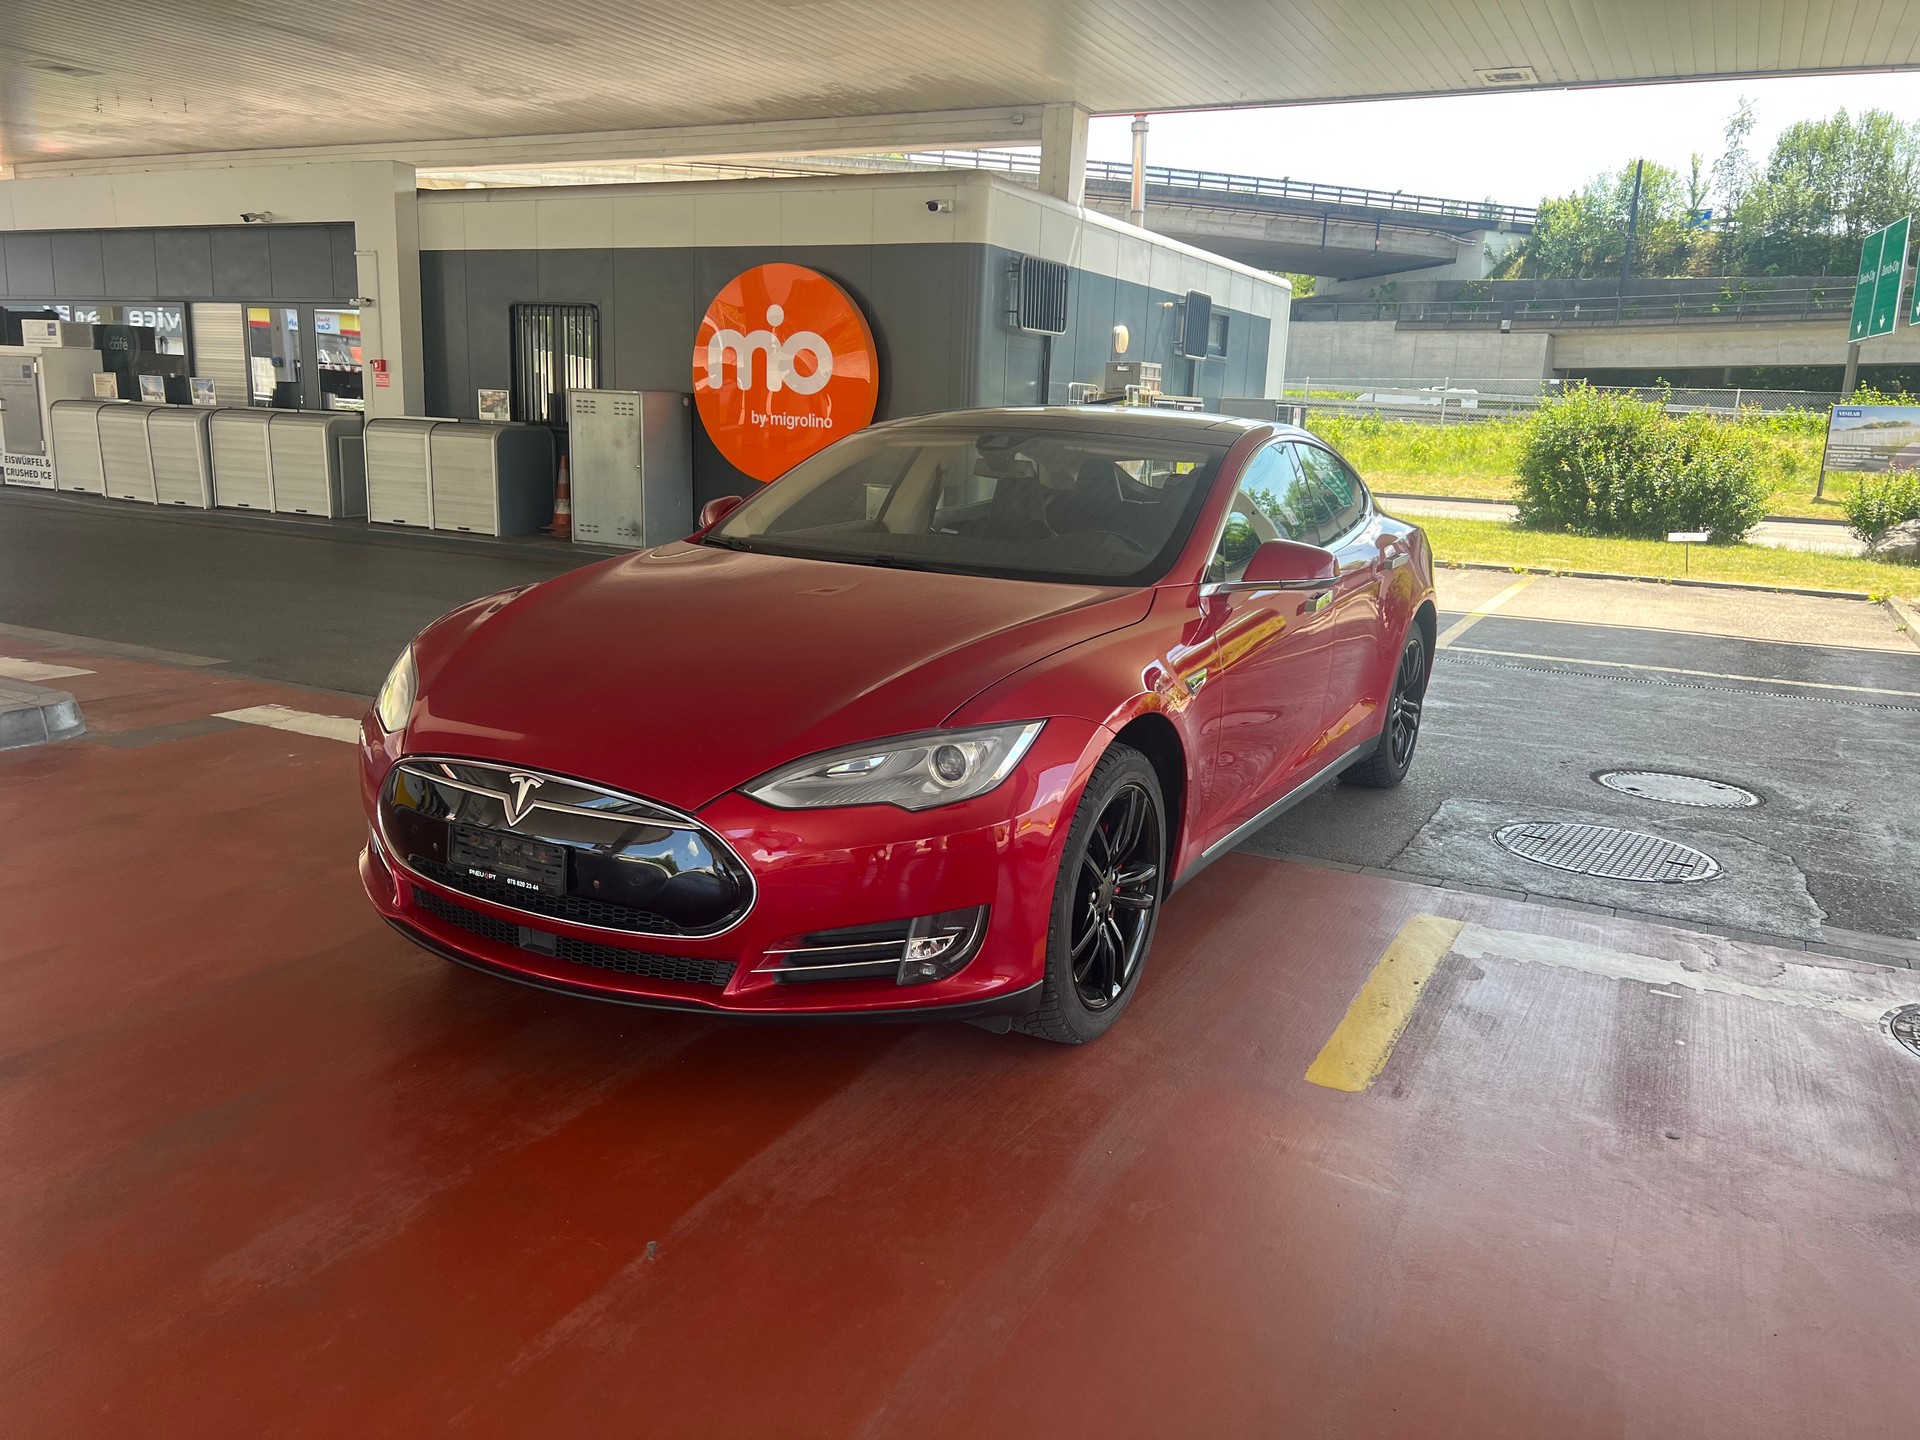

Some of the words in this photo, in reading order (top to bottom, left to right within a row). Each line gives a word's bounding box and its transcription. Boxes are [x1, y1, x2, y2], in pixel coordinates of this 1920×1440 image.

[109, 337, 129, 351] café
[708, 304, 833, 395] mio
[751, 410, 767, 428] by
[770, 412, 833, 429] migrolino
[4, 455, 44, 467] EISWÜRFEL
[45, 459, 51, 468] &
[5, 467, 39, 479] CRUSHED
[40, 470, 52, 480] ICE
